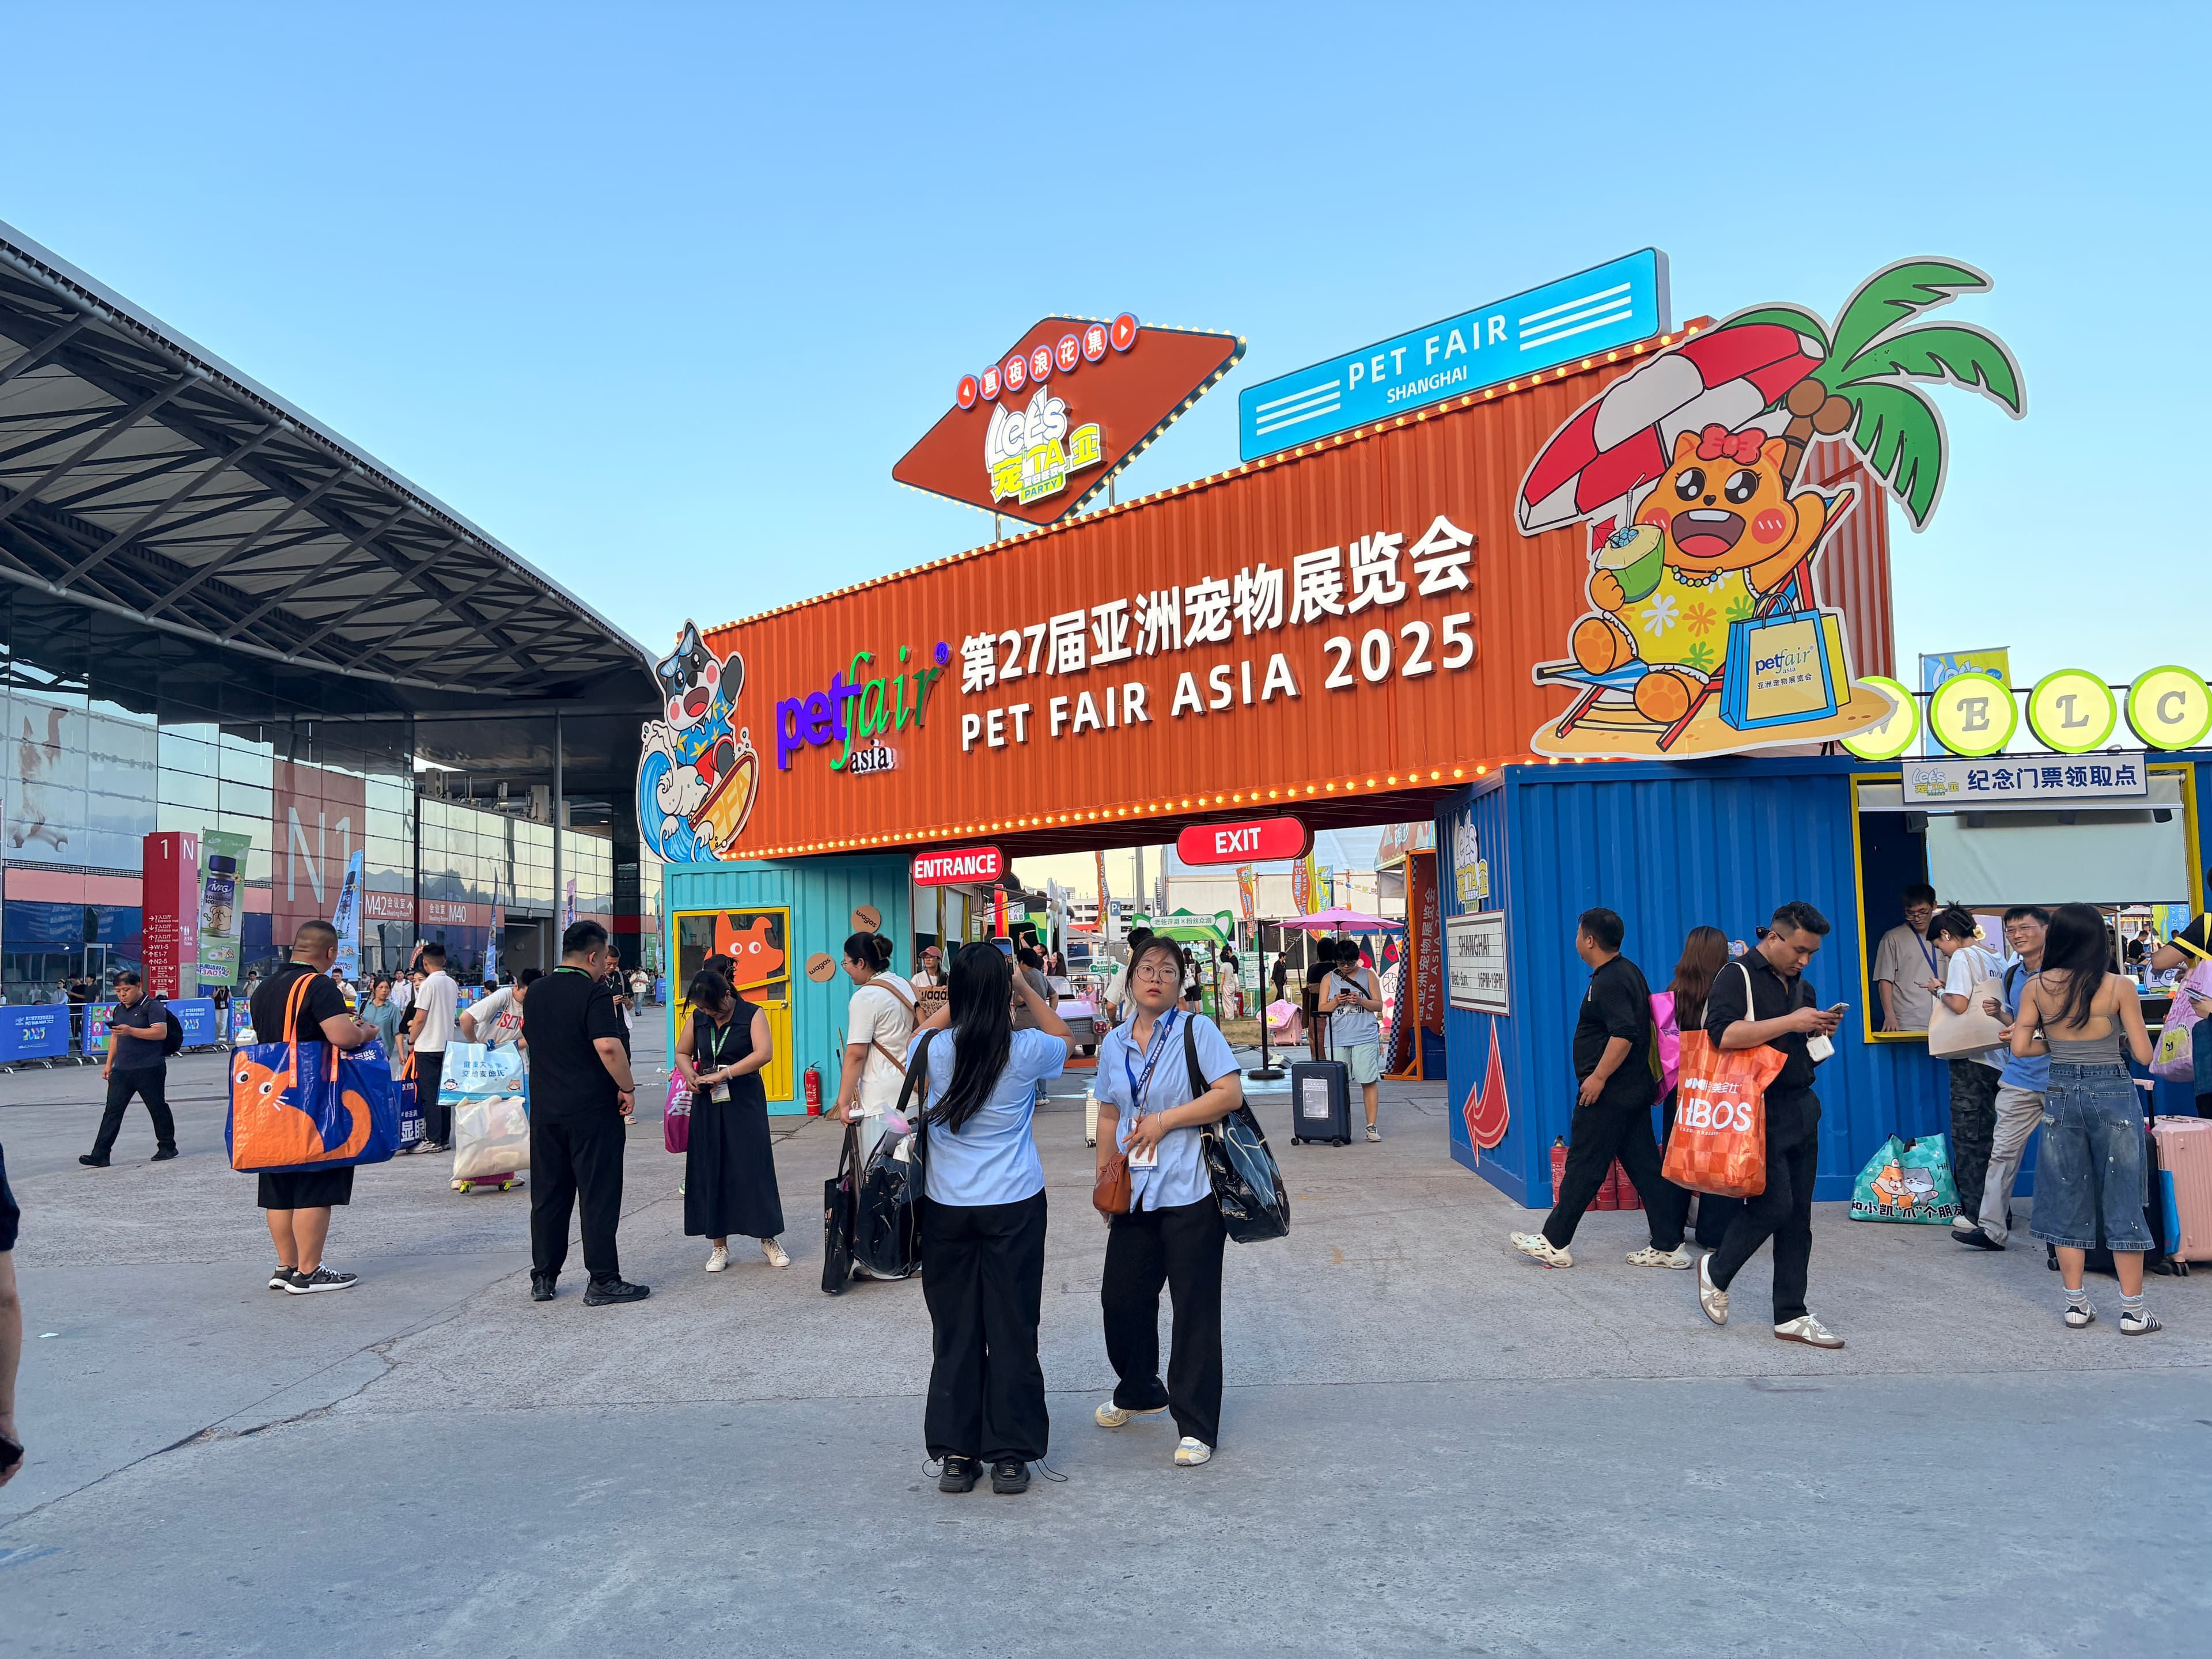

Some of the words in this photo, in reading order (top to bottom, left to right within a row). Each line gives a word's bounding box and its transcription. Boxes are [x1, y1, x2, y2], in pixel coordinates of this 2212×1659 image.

[1349, 347, 1407, 391] PET
[1425, 315, 1508, 366] FAIR
[1387, 365, 1468, 403] SHANGHAI
[1025, 479, 1058, 498] PARTY
[960, 514, 1476, 694] 第27届亚洲宠物展览会
[961, 703, 1033, 752] PET
[1050, 681, 1149, 738] FAIR
[1171, 653, 1300, 717] ASIA
[1324, 612, 1475, 691] 2025
[1757, 673, 1812, 690] 亚洲宠物展览会
[849, 740, 892, 774] asia
[1967, 764, 2137, 791] 纪念门票领取点
[183, 839, 194, 860] N
[1215, 827, 1262, 854] EXIT
[914, 854, 997, 878] ENTRANCE
[365, 895, 387, 915] M42
[388, 896, 406, 909] 会议室
[429, 903, 445, 915] 会议室
[449, 904, 467, 922] M40
[855, 910, 877, 928] wagas
[1459, 933, 1490, 957] SHANGHAI
[808, 958, 831, 975] wagas
[1425, 983, 1437, 1020] FAIR
[1431, 937, 1441, 975] ASIA
[922, 990, 949, 1001] aga
[1937, 1162, 1949, 1171] Hi!
